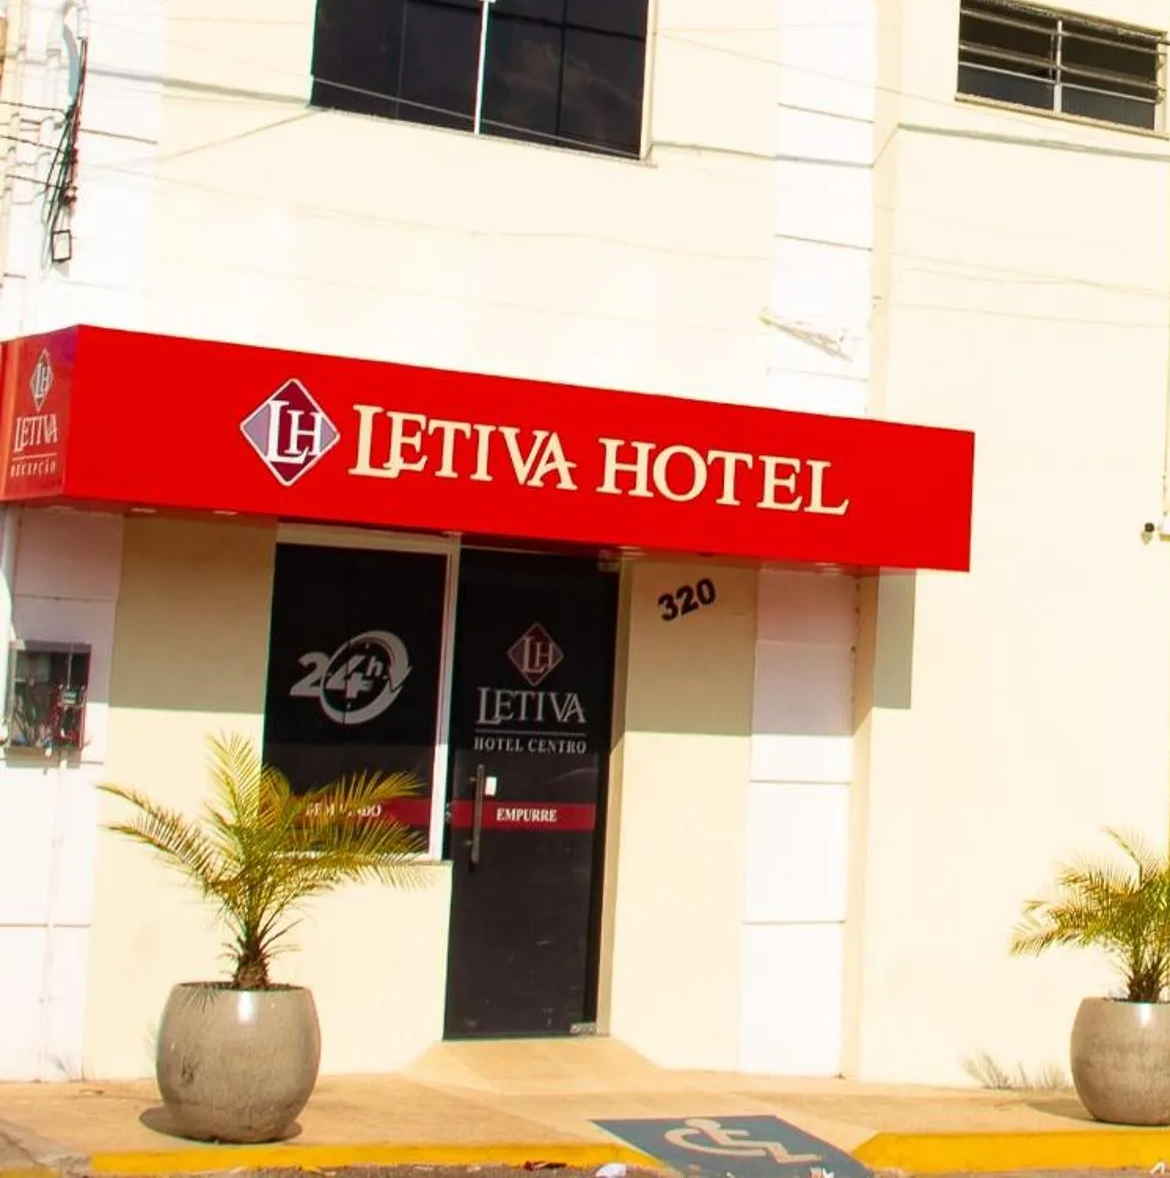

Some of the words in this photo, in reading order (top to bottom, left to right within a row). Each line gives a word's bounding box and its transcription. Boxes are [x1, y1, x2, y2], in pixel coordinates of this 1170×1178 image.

[13, 413, 58, 454] LETIVA
[264, 399, 325, 465] LH
[348, 404, 578, 491] LETIVA
[596, 437, 850, 516] HOTEL
[657, 577, 717, 622] 320
[521, 635, 555, 674] LH
[476, 686, 587, 725] LETIVA
[473, 736, 524, 753] HOTEL
[527, 738, 588, 755] CENTRO
[496, 807, 558, 822] EMPURRE
